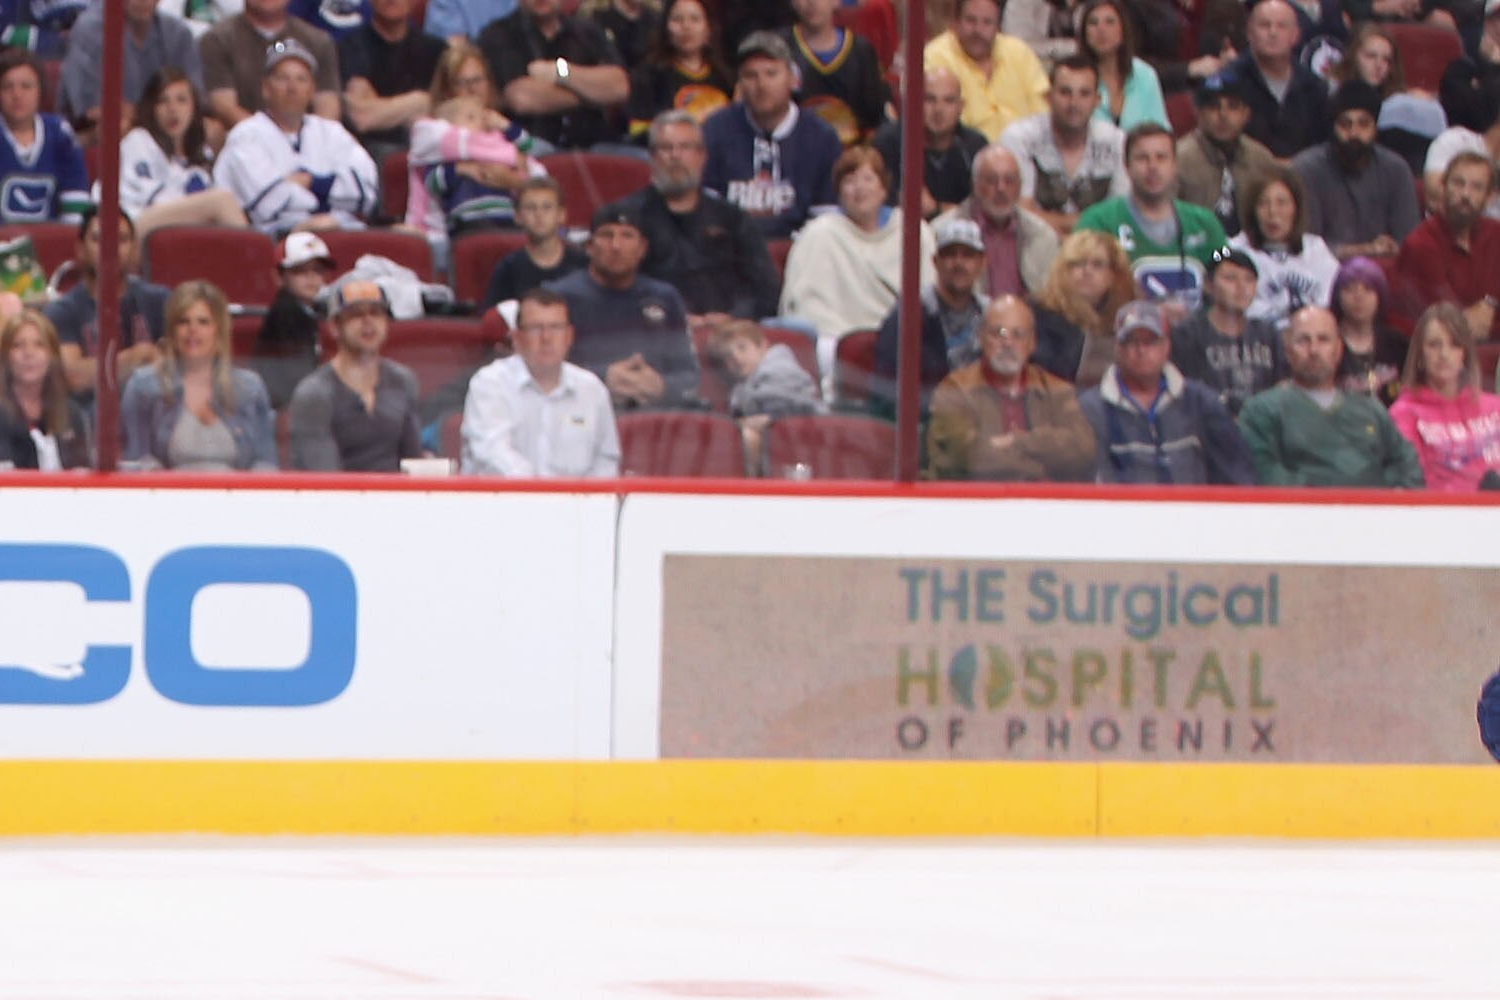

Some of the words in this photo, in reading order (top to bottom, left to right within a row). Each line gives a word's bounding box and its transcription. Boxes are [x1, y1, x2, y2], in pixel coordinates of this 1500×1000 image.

[898, 569, 1005, 622] THE
[1026, 571, 1279, 641] Surgical
[895, 644, 1277, 711] HOSPITAL
[895, 717, 965, 751] OF
[1005, 718, 1276, 752] PHOENIX
